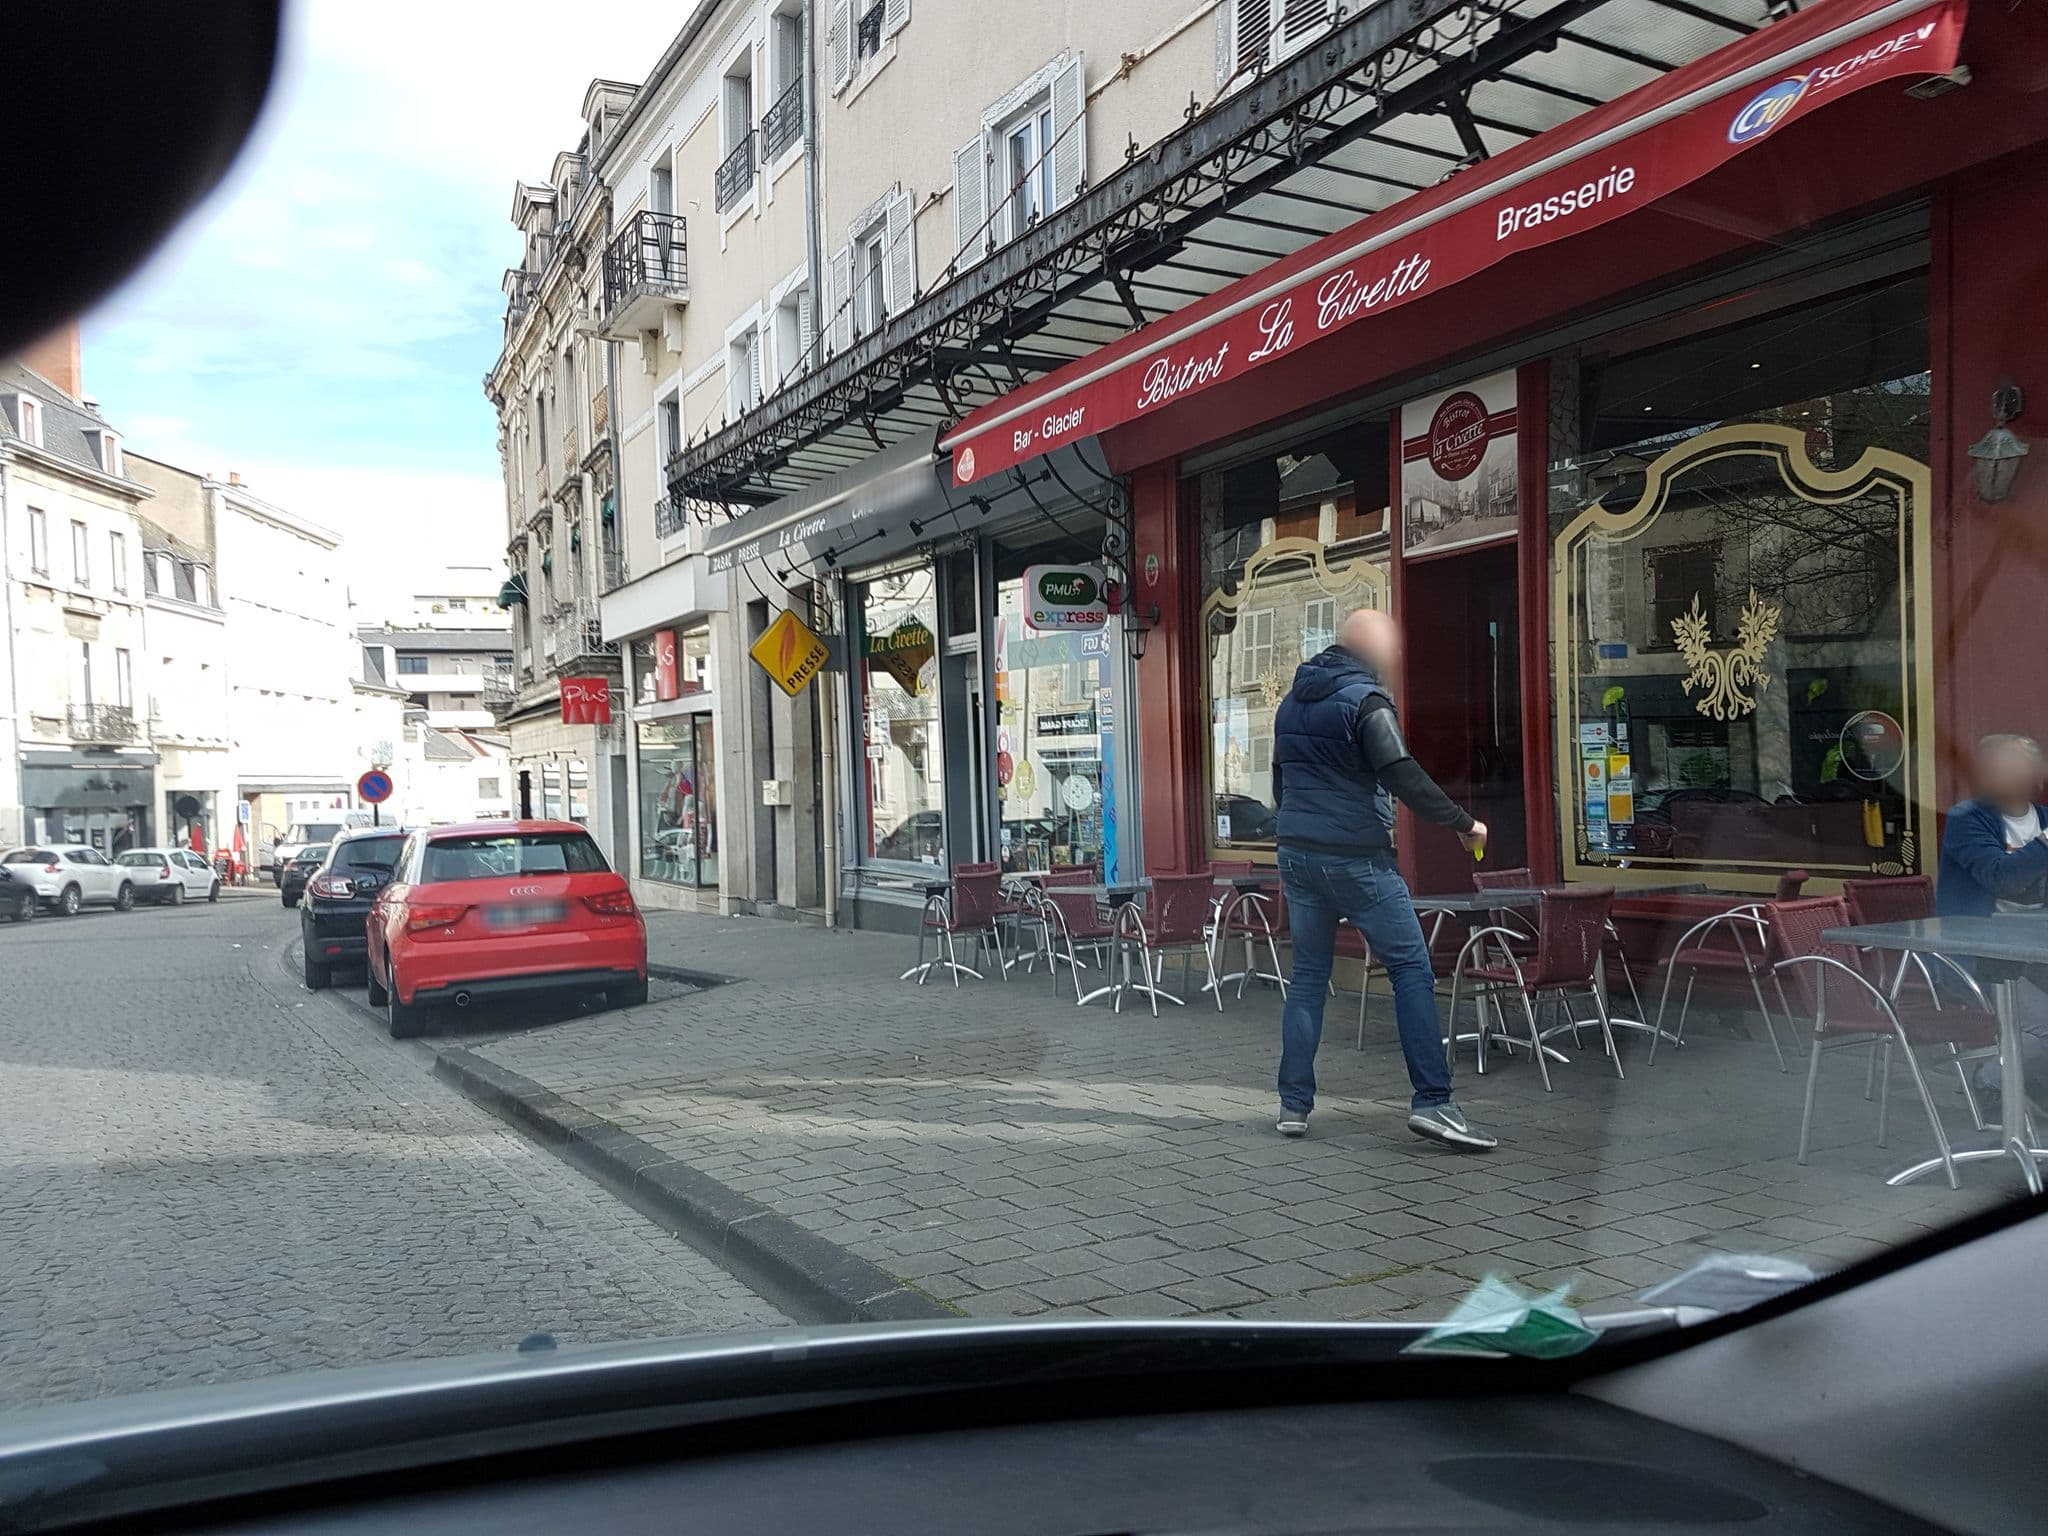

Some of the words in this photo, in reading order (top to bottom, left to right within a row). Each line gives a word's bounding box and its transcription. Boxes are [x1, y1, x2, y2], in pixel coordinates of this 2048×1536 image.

[1495, 165, 1636, 242] Brasserie
[1137, 342, 1230, 409] Bistrot
[1248, 297, 1295, 362] La
[1316, 253, 1432, 330] Civette
[1013, 429, 1033, 452] Bar
[1042, 405, 1085, 440] Glacier
[1446, 422, 1484, 452] Civette
[778, 530, 791, 548] La
[793, 516, 827, 544] Civette
[1045, 583, 1072, 596] PMU
[1033, 610, 1105, 628] express
[869, 635, 884, 653] La
[888, 626, 929, 651] Civette
[1083, 636, 1099, 652] FDJ
[786, 644, 825, 690] PRESSE
